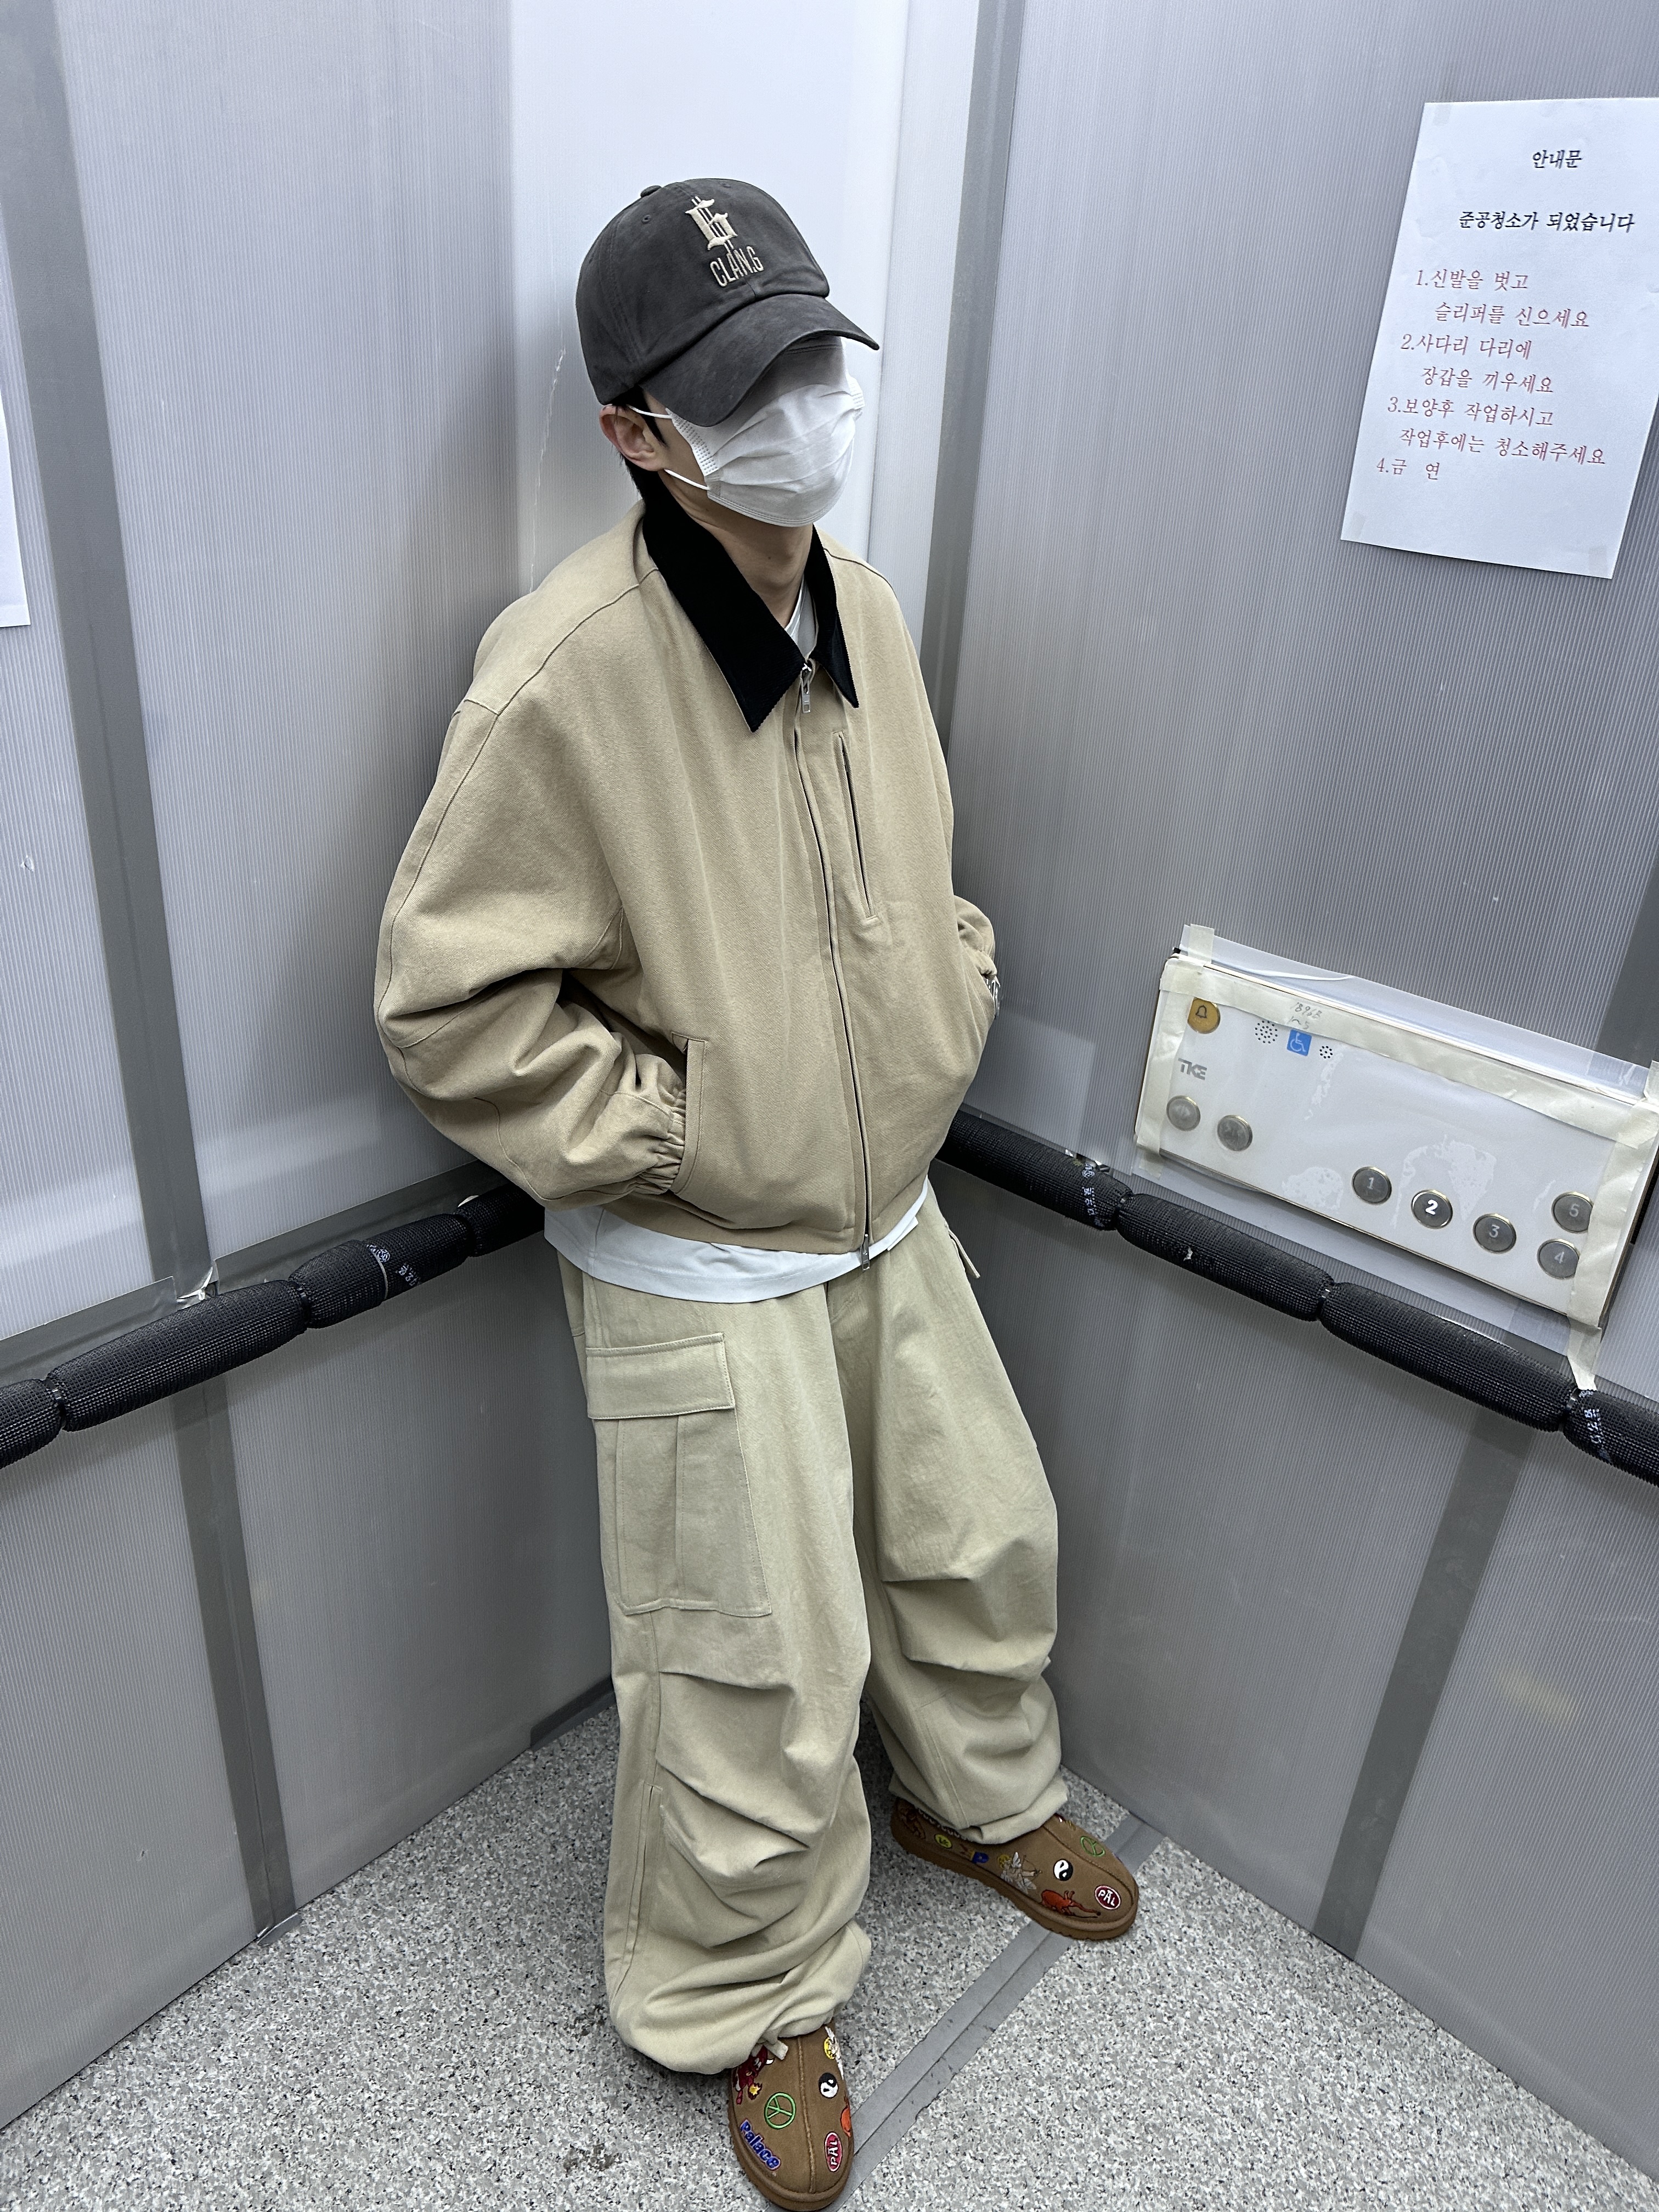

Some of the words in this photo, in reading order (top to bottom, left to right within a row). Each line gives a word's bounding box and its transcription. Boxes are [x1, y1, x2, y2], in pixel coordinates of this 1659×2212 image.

[1533, 150, 1583, 169] 안내문
[1459, 211, 1539, 230] 준공청소가
[1546, 212, 1635, 233] 되었습니다
[709, 246, 764, 287] CLAN.G
[1416, 269, 1483, 289] 1.신발을
[1495, 271, 1528, 291] 벗고
[1435, 302, 1505, 324] 슬리퍼를
[1516, 307, 1589, 329] 신으세요
[1401, 334, 1468, 356] 2.사다리
[1480, 338, 1532, 359] 다리에
[1421, 366, 1472, 387] 장갑을
[1483, 371, 1553, 393] 끼우세요
[1388, 397, 1454, 418] 3.보양후
[1465, 403, 1553, 426] 작업하시고
[1400, 428, 1485, 453] 작업후에는
[1496, 438, 1605, 465] 청소해주세요
[1376, 458, 1407, 475] 4.금
[1426, 462, 1440, 479] 연
[1178, 1058, 1207, 1080] TKE
[1367, 1177, 1375, 1189] 1
[1425, 1200, 1438, 1215] 2
[1568, 1203, 1581, 1217] 5
[1488, 1224, 1500, 1238] 3
[1554, 1251, 1565, 1264] 4
[1098, 1890, 1115, 1906] PAL
[740, 2119, 782, 2170] Palace
[828, 2139, 839, 2166] PAL
